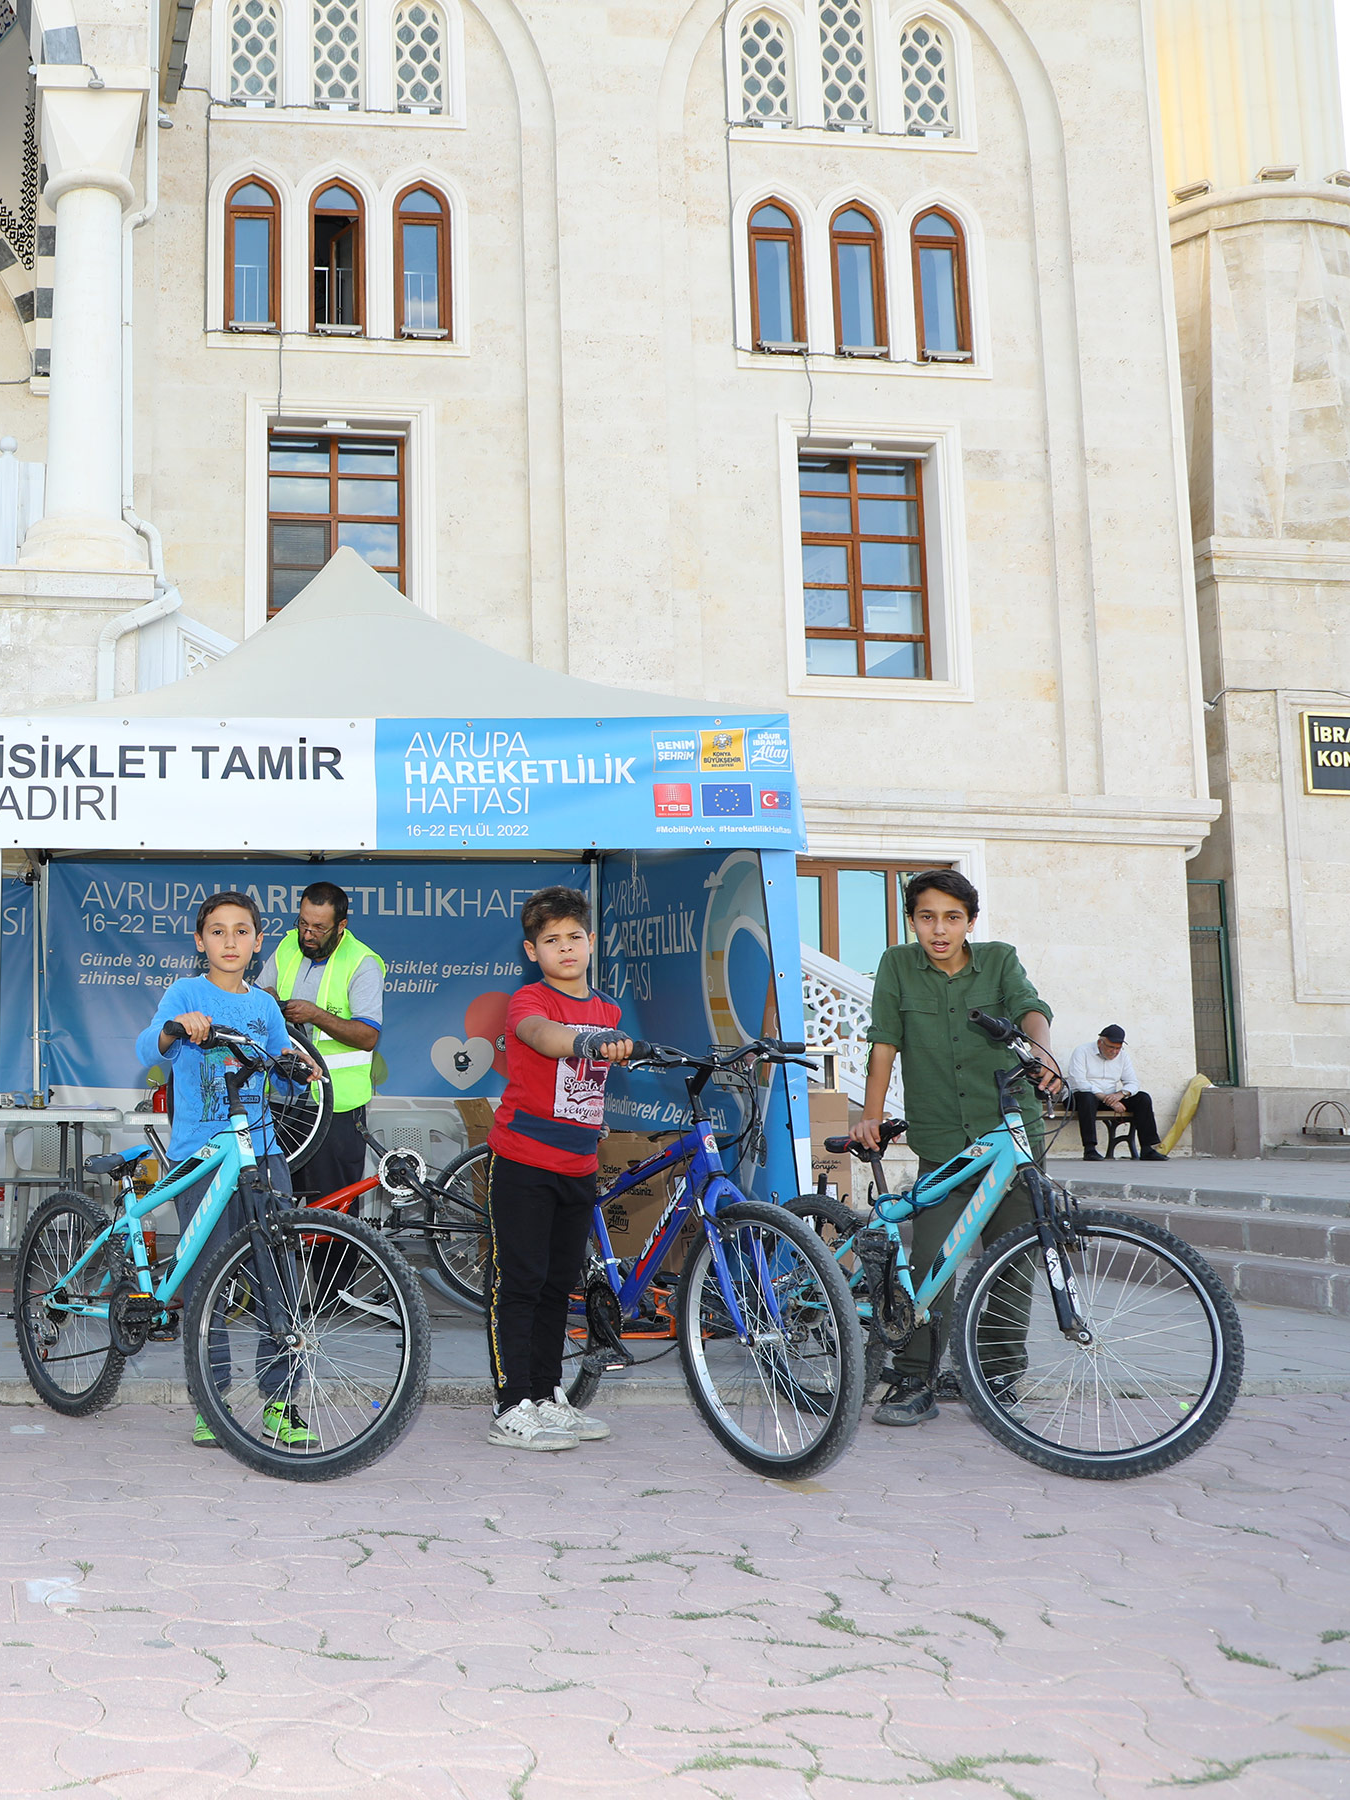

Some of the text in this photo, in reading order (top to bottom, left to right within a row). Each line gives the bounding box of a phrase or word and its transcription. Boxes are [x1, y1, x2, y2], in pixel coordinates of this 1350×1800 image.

[405, 731, 530, 758] AVRUPA
[757, 732, 781, 740] UĞUR
[192, 736, 344, 781] TAMİR
[751, 745, 789, 764] Altay
[405, 752, 637, 785] HAREKETLİLİK
[405, 785, 530, 815] HAFTASI
[657, 804, 691, 812] TBB
[450, 821, 494, 837] EYLÜL
[497, 823, 529, 837] 2022
[656, 826, 716, 835] #MobilityWeek
[152, 915, 197, 935] EYL
[80, 952, 132, 967] Günde
[136, 954, 156, 968] 30
[441, 962, 489, 979] gezisi
[493, 962, 523, 976] bile
[78, 972, 141, 986] zihinsel
[384, 979, 439, 993] olabilir
[661, 1102, 694, 1127] Deva
[710, 1107, 727, 1131] Et!
